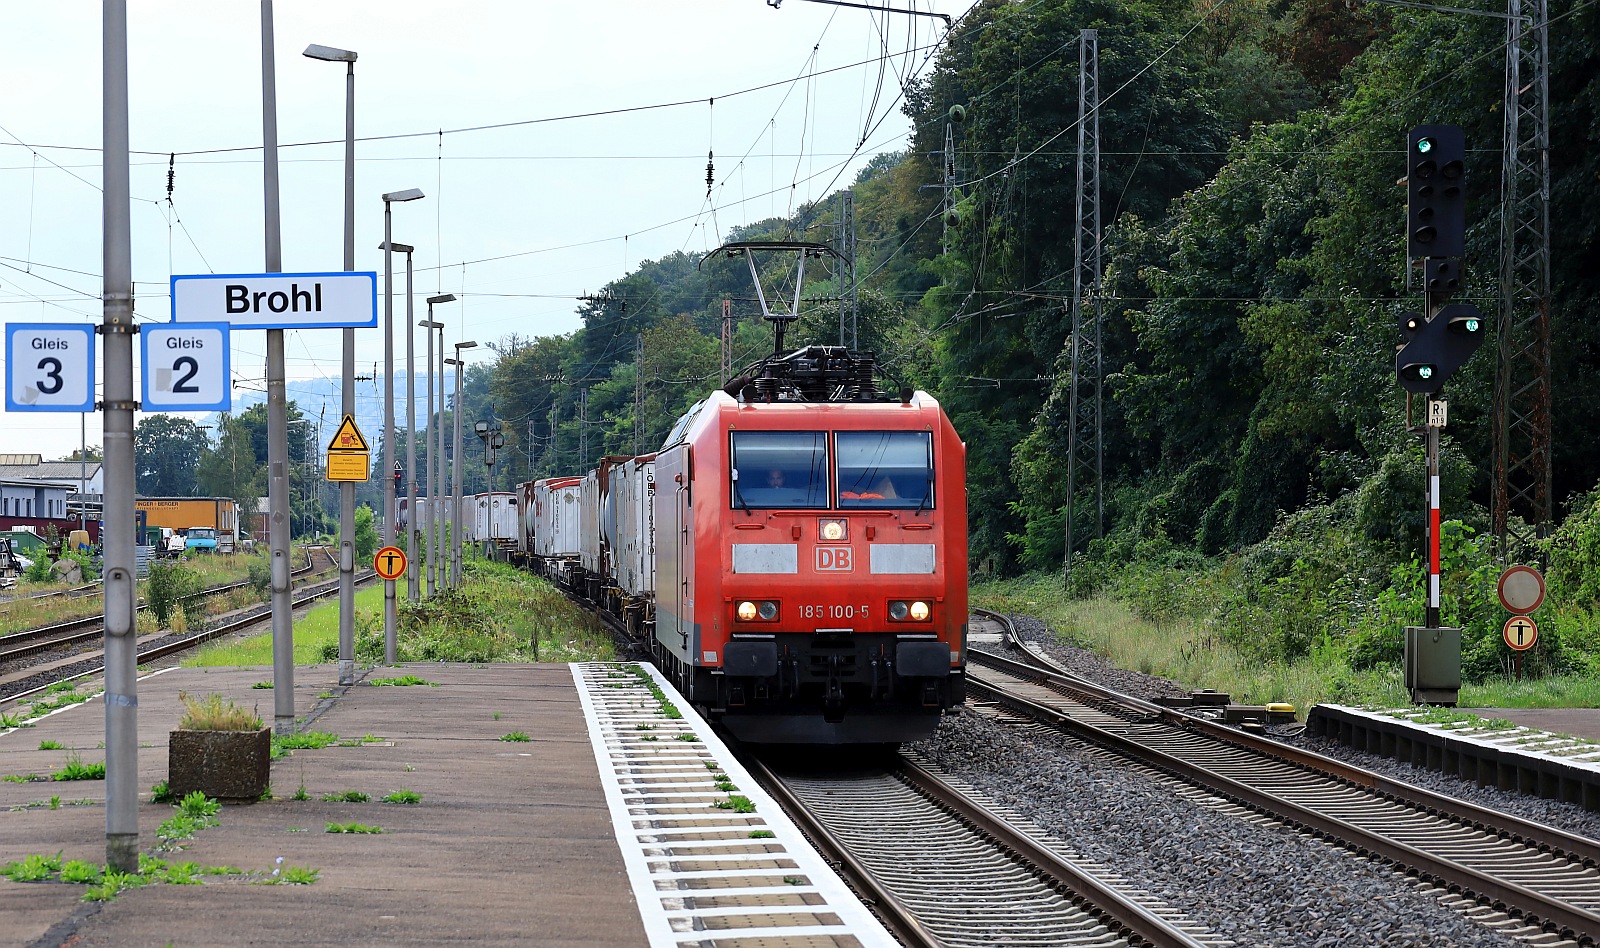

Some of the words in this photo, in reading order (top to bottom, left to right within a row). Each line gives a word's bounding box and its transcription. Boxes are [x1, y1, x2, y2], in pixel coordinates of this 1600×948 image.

[225, 283, 322, 314] Brohl
[31, 337, 69, 351] Gleis
[166, 336, 204, 350] Gleis
[36, 356, 64, 395] 3
[172, 356, 200, 394] 2
[818, 549, 850, 568] DB
[799, 605, 824, 619] 185
[828, 605, 869, 619] 100-5
